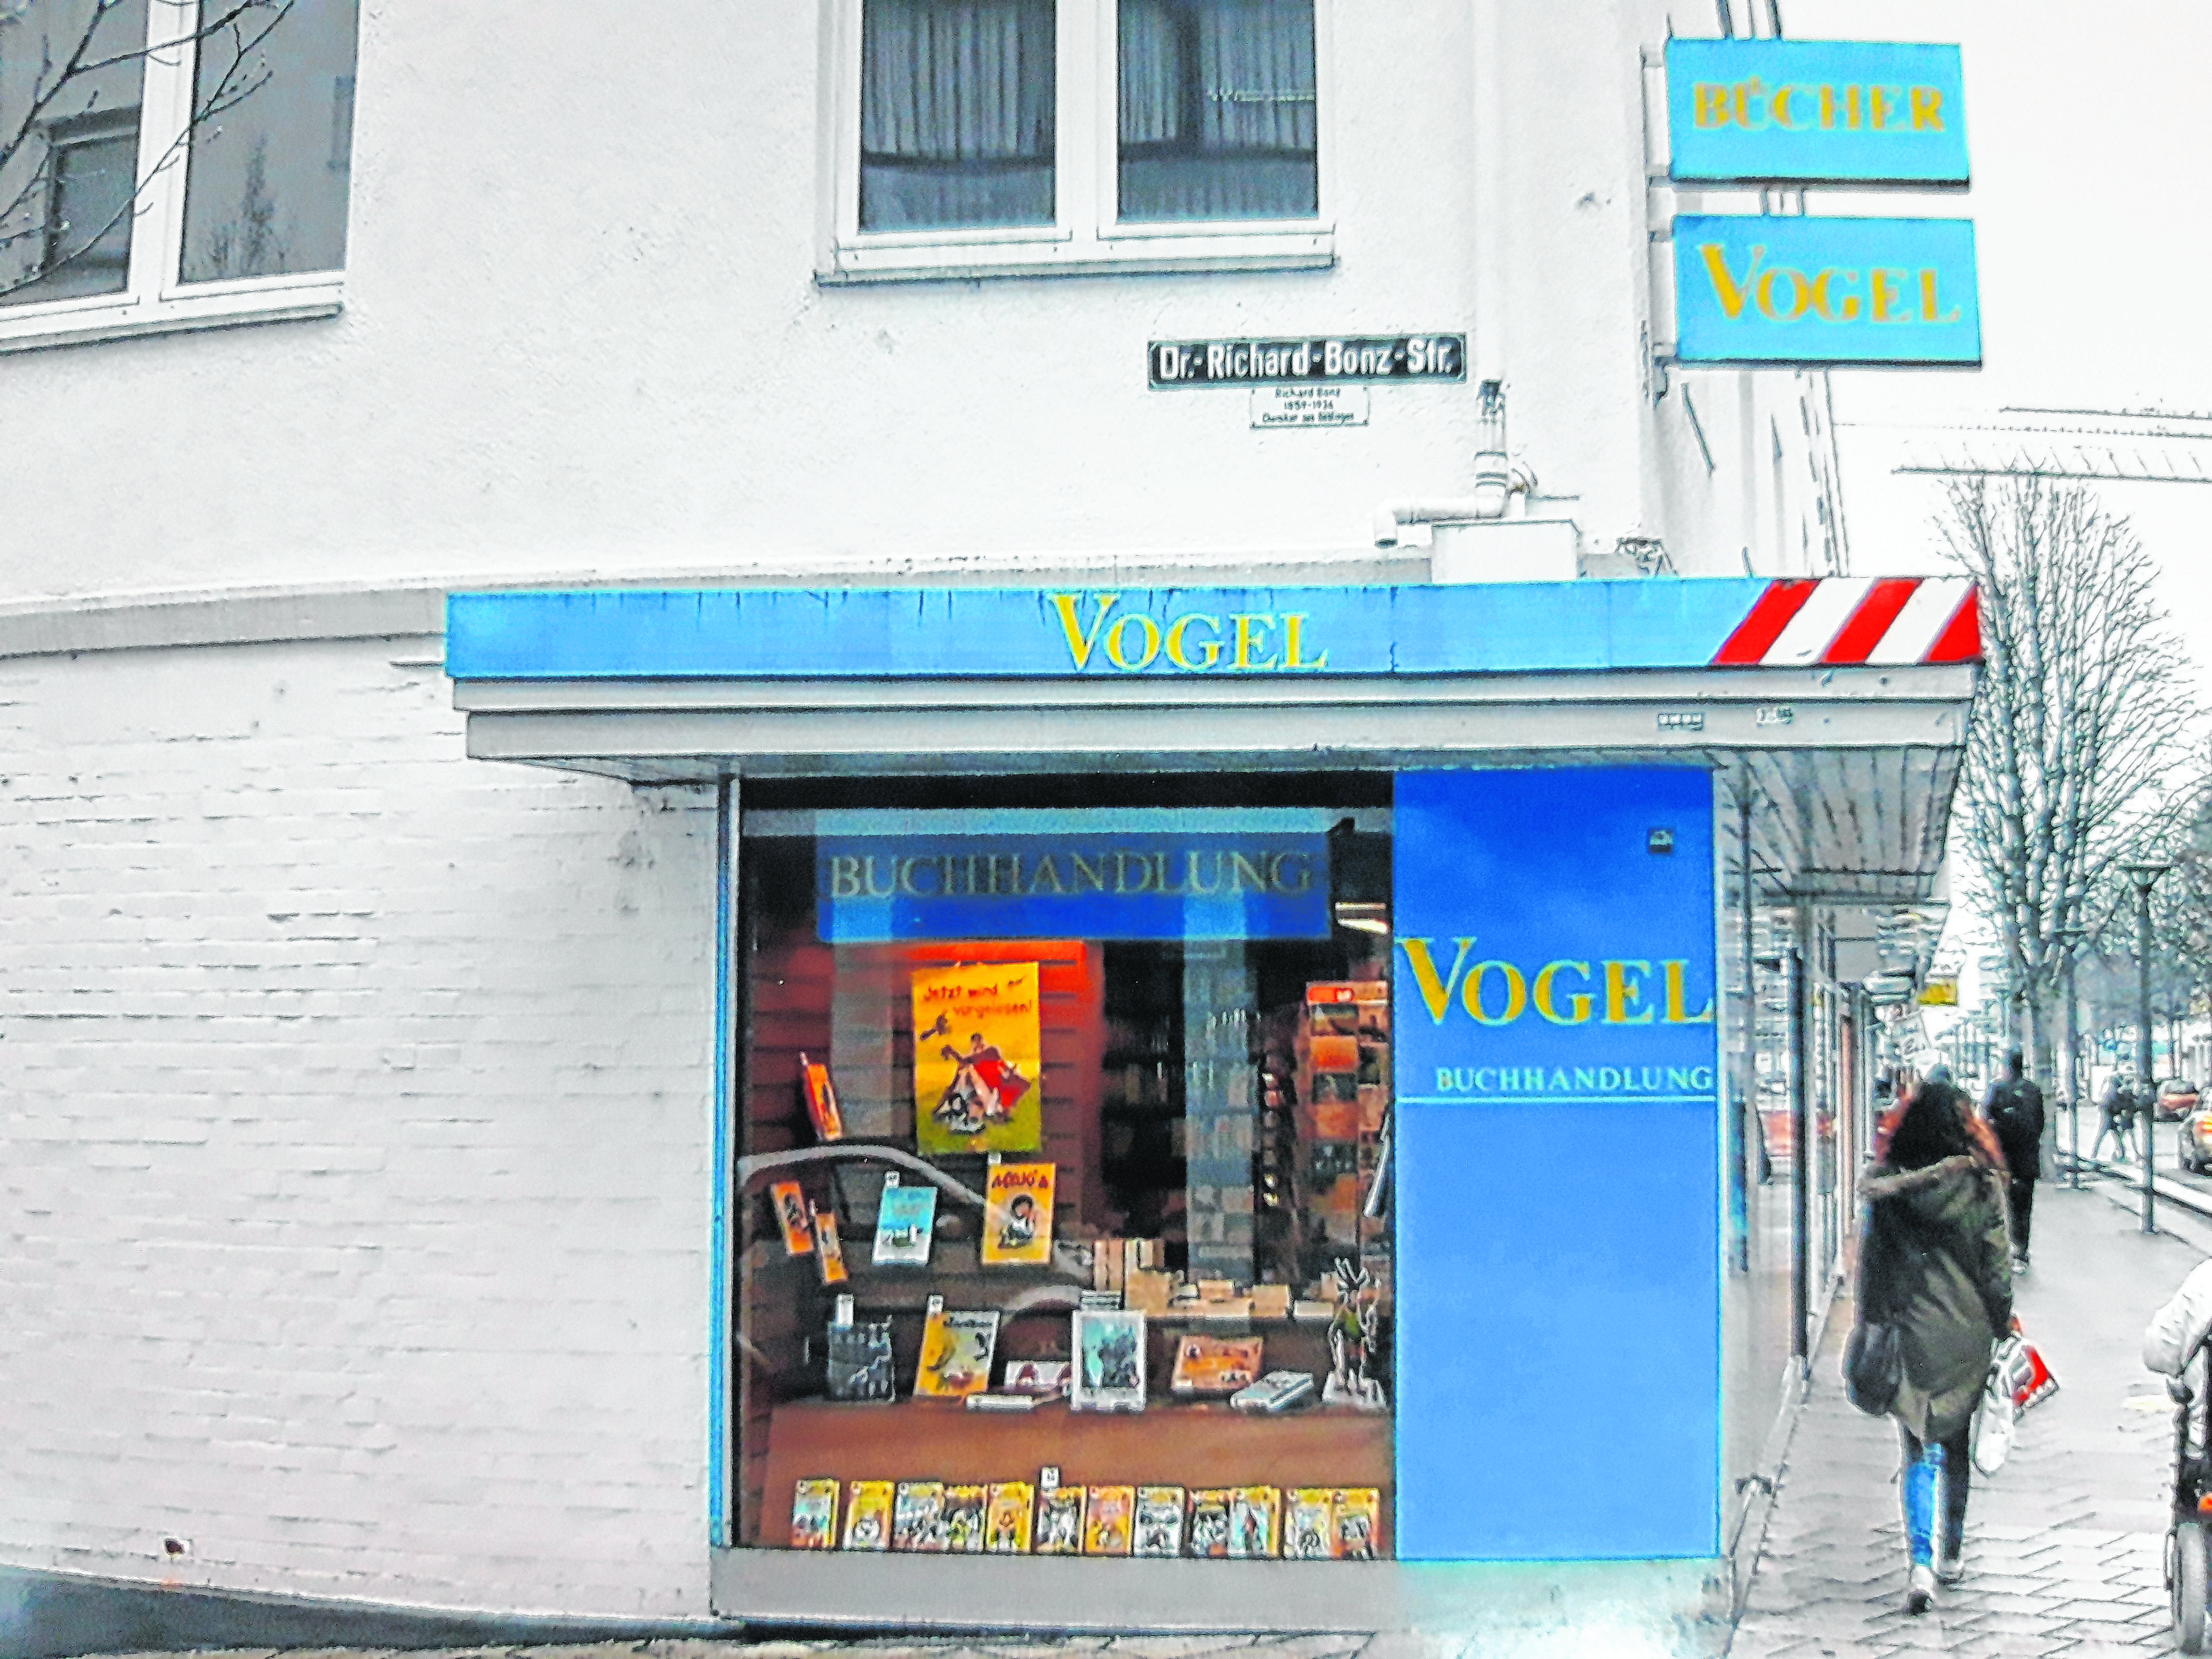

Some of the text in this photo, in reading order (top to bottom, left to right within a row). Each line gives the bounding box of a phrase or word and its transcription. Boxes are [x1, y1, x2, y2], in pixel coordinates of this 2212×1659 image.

[1699, 244, 1961, 322] VOGEL
[1159, 338, 1453, 380] Dr.-Richard-Bonz-Str.
[1049, 593, 1328, 671] VOGEL
[830, 851, 1313, 899] BUCHHANDLUNG
[1394, 936, 1714, 1026] VOGEL
[1436, 1065, 1713, 1092] BUCHHANDLUNG
